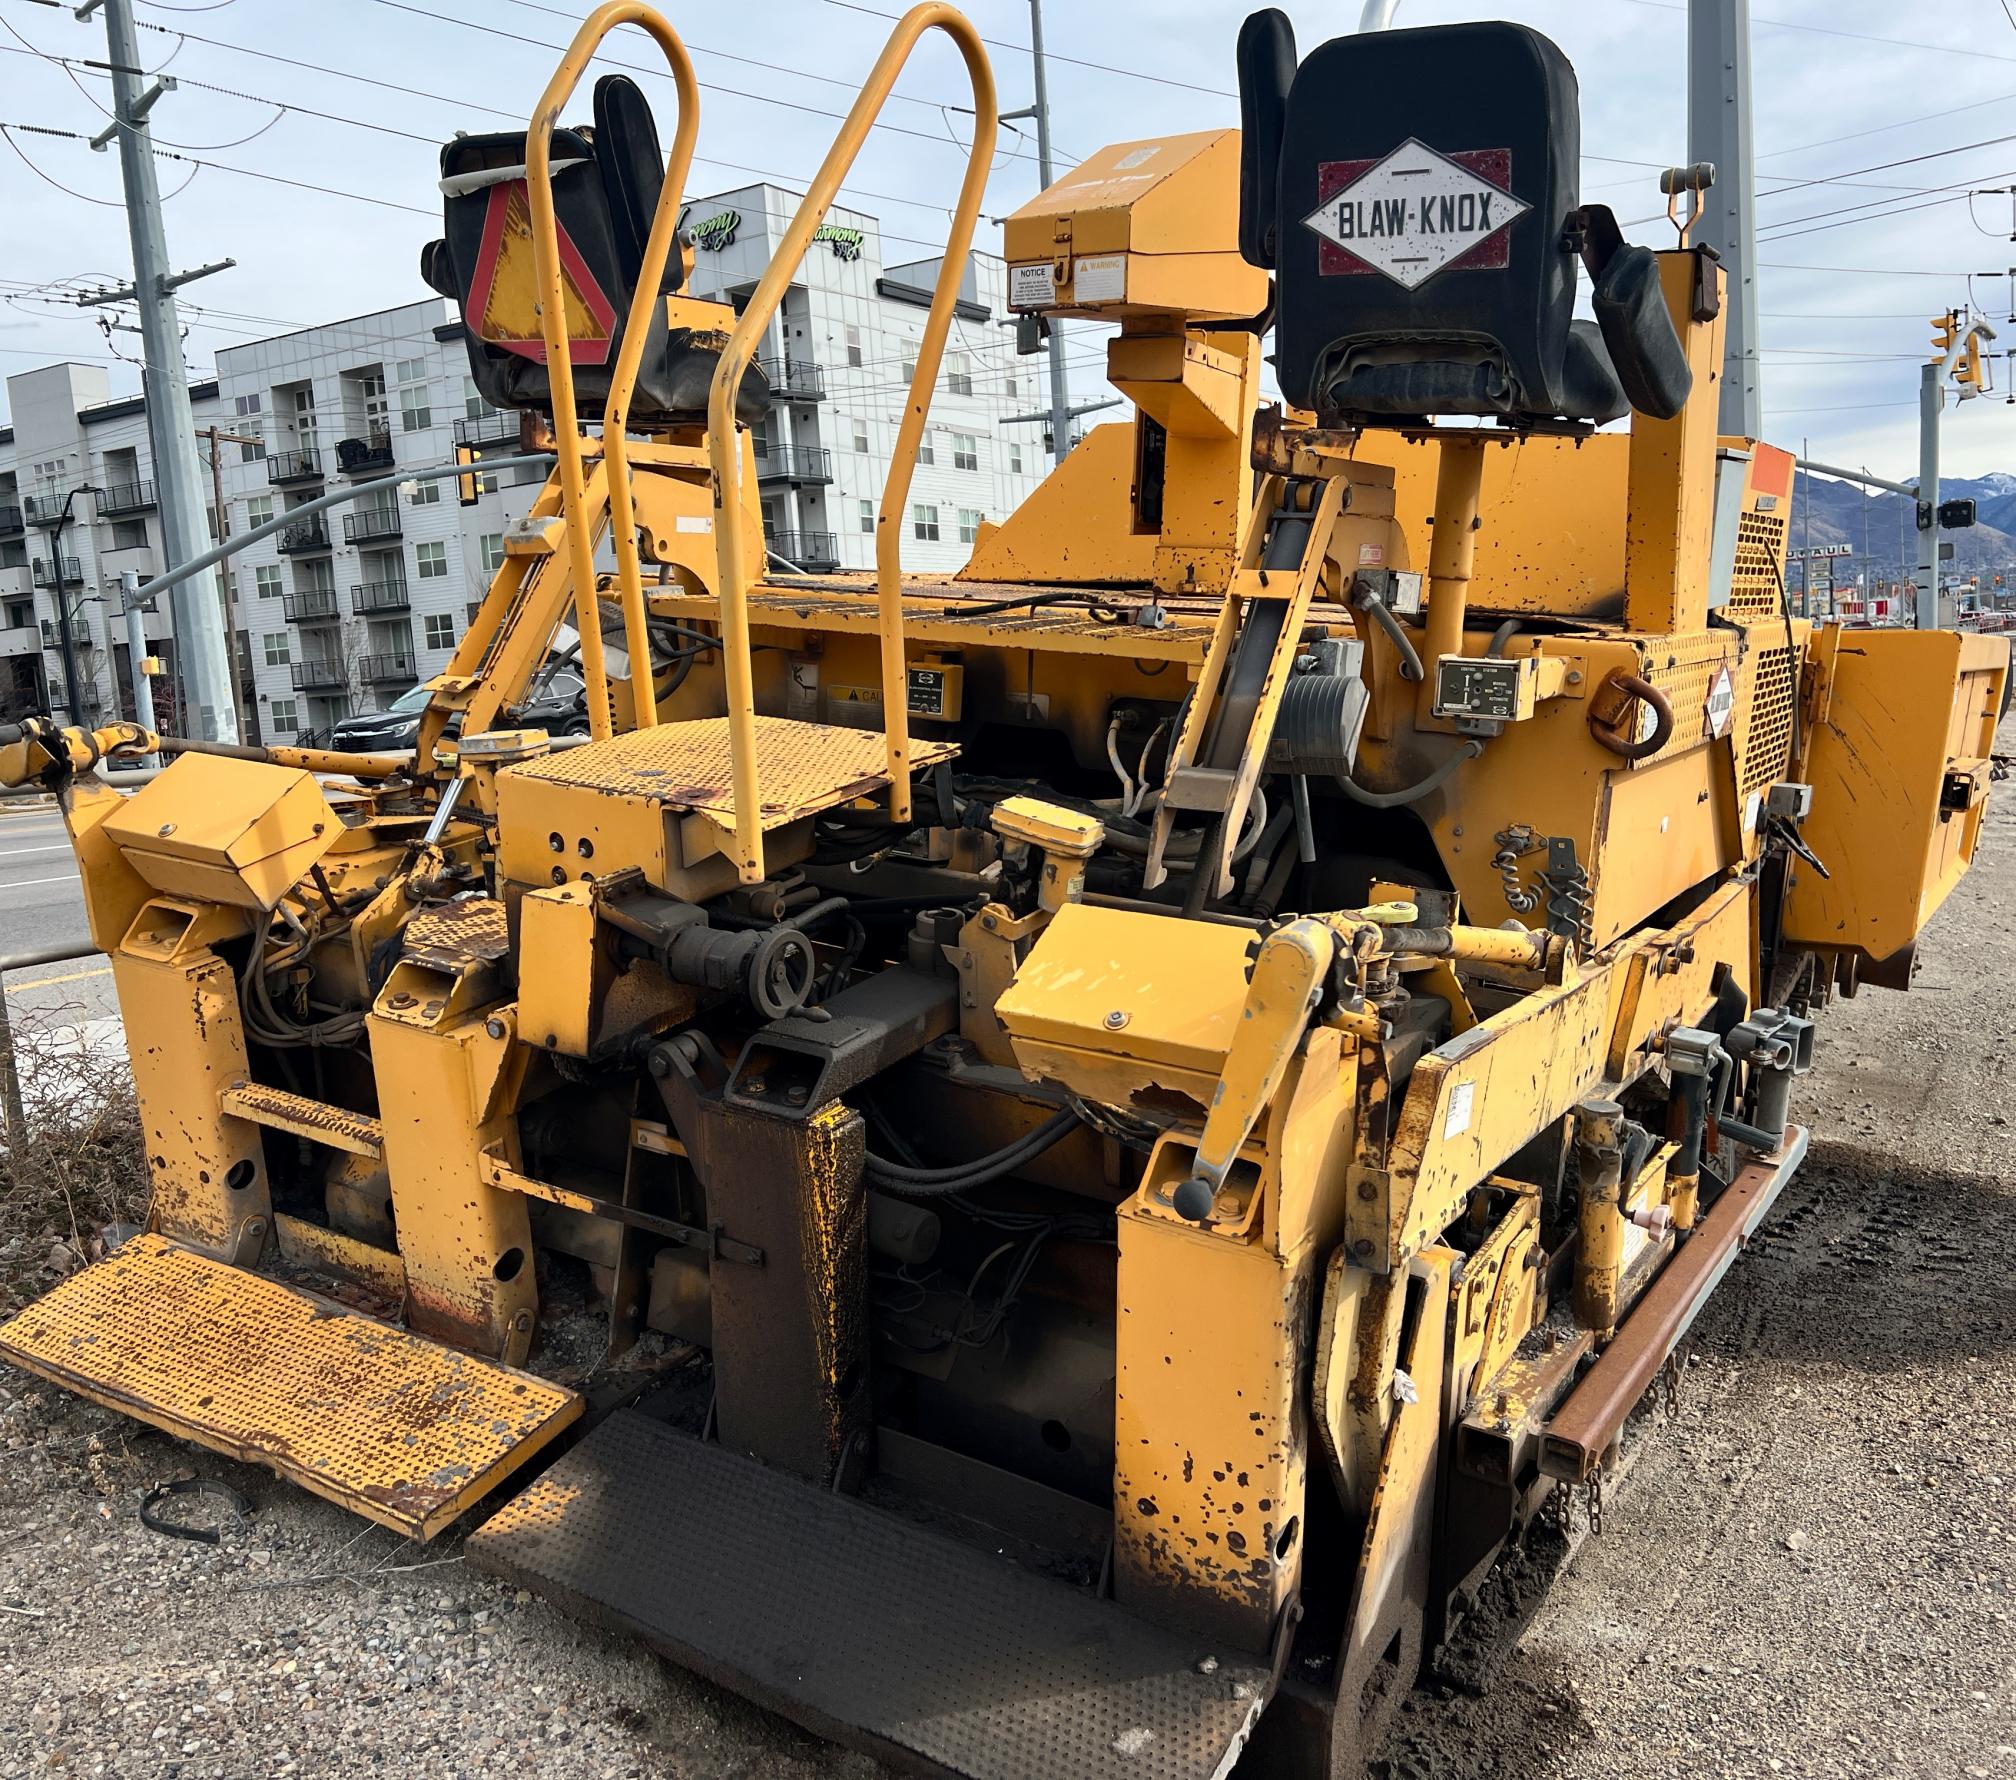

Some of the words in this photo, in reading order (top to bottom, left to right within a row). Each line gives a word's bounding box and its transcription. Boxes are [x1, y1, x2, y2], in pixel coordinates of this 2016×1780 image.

[1338, 191, 1493, 240] BLAW-KNOX
[813, 223, 865, 261] armony
[1020, 268, 1046, 278] NOTICE
[1090, 260, 1120, 270] WARNING
